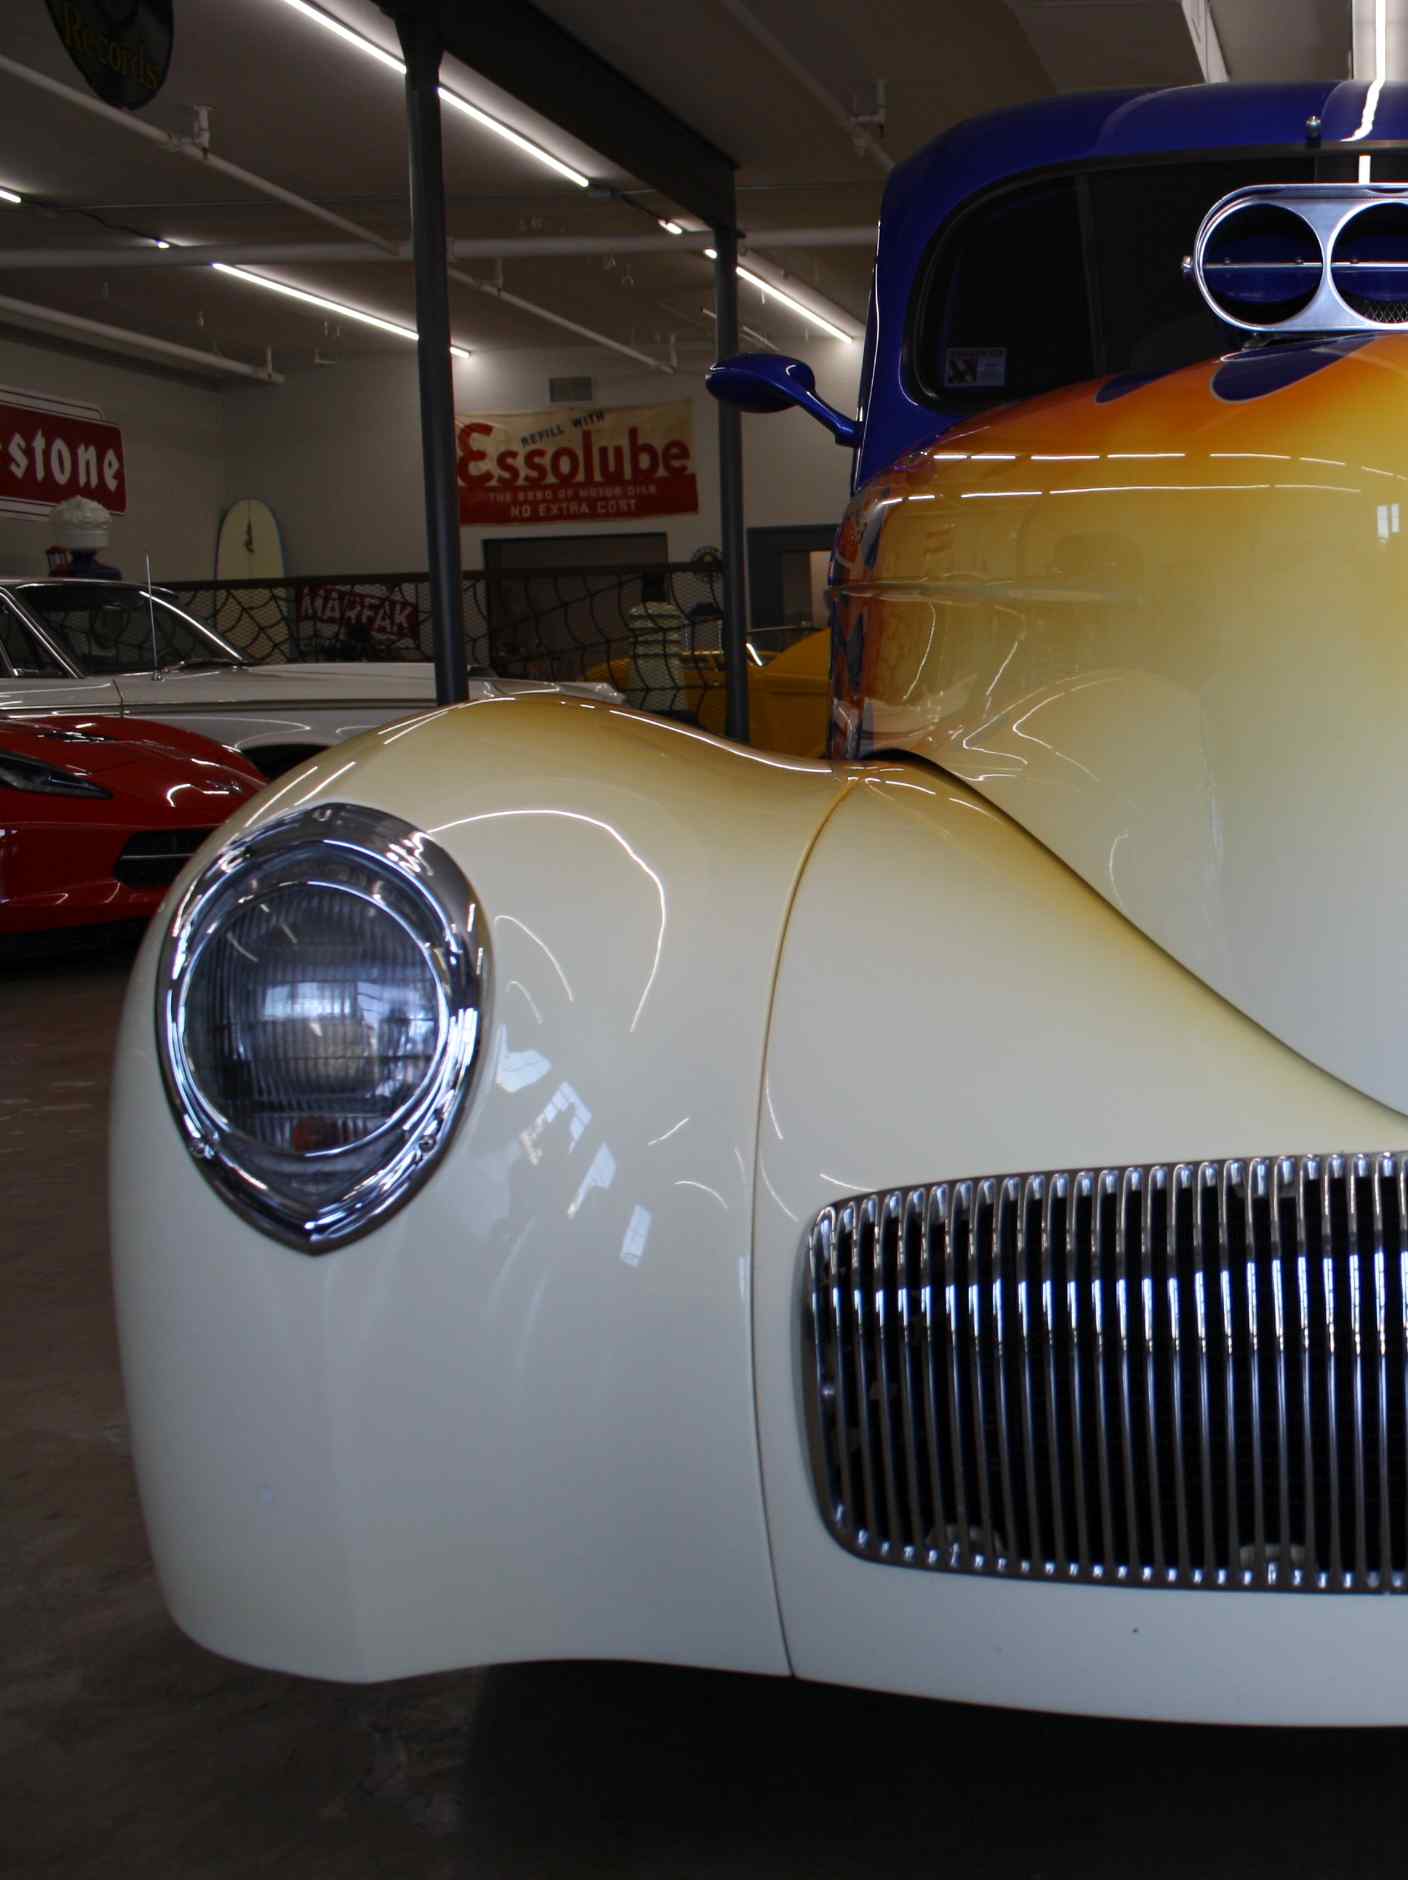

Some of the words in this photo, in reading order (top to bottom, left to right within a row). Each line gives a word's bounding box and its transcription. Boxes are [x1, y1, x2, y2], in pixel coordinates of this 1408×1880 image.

[520, 424, 562, 447] REFILL
[572, 409, 606, 429] WITH
[0, 428, 120, 493] stone
[456, 422, 692, 488] Essolube
[510, 503, 531, 518] NO
[538, 501, 590, 517] EXTRA
[597, 498, 637, 513] COST
[301, 584, 416, 633] MARFAK
